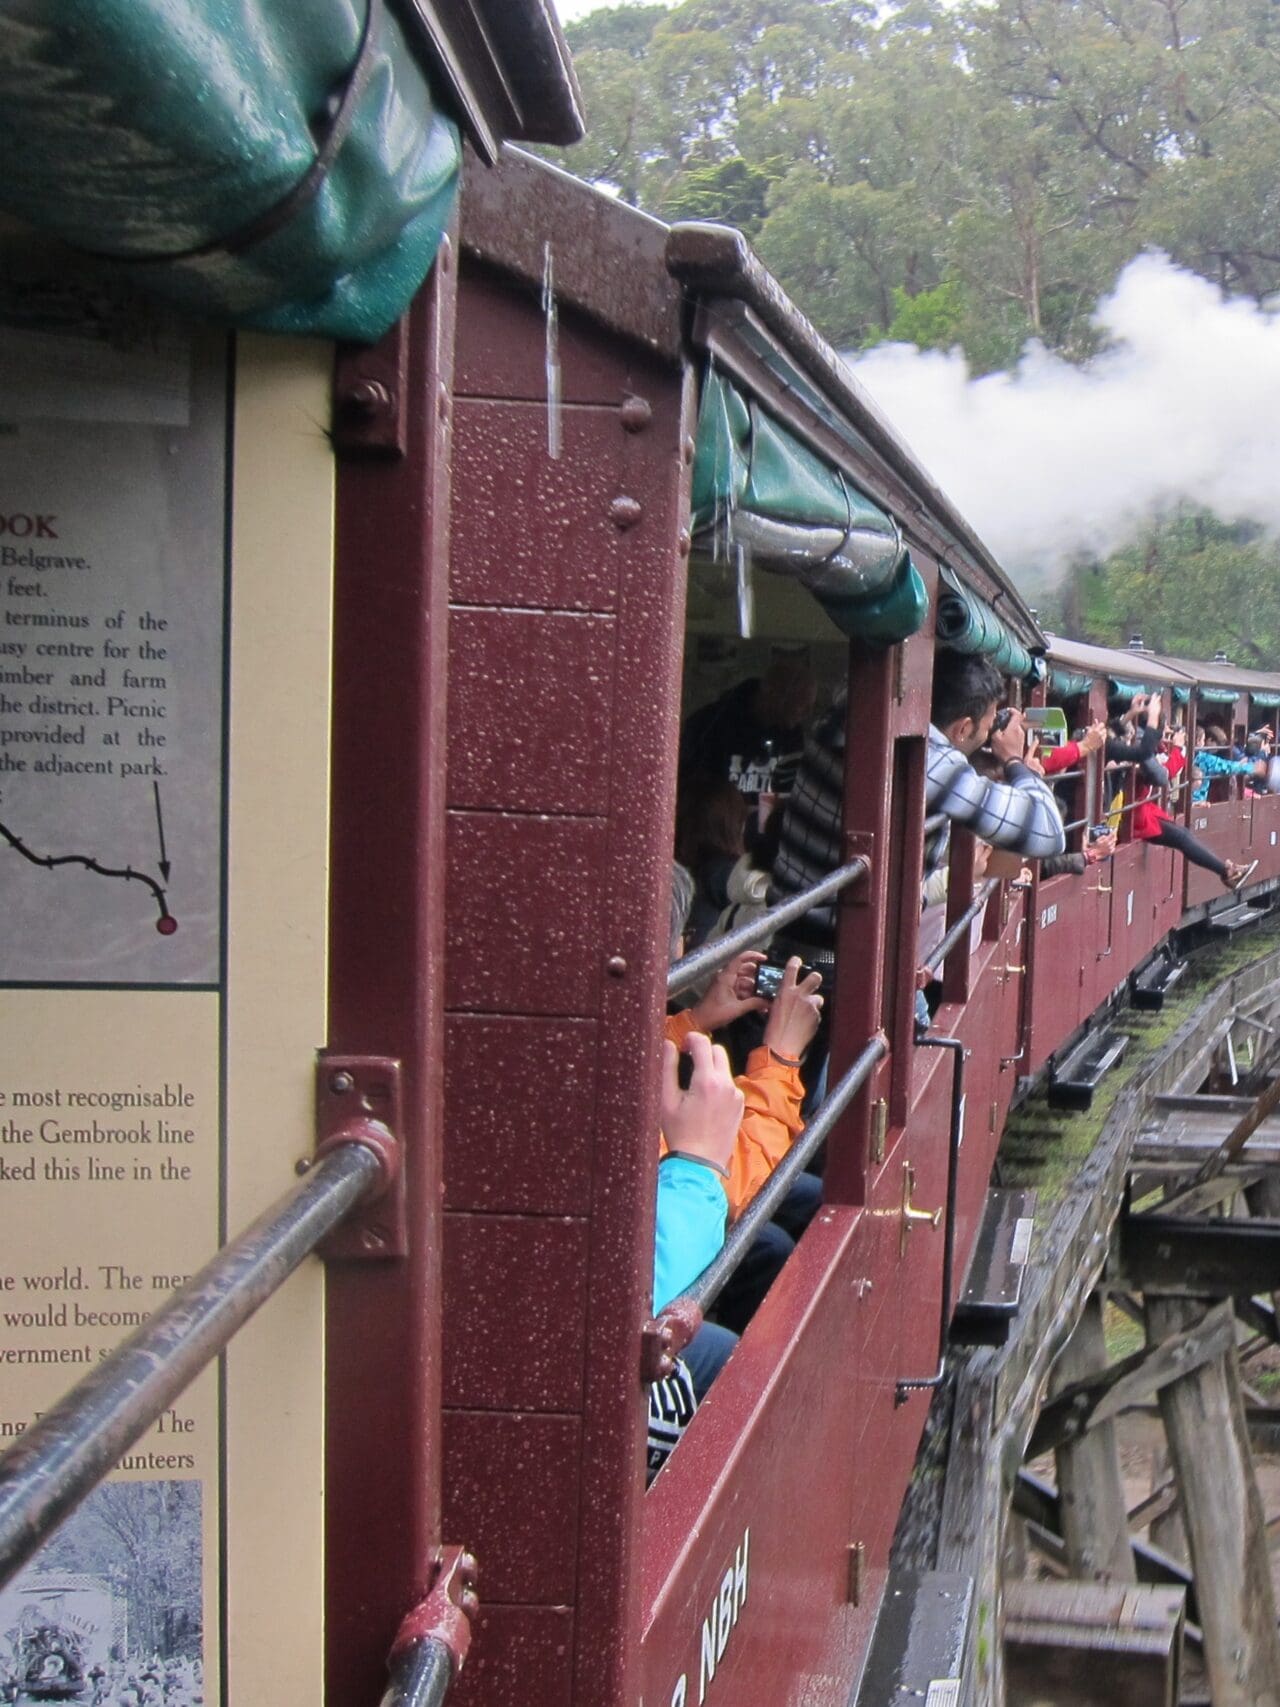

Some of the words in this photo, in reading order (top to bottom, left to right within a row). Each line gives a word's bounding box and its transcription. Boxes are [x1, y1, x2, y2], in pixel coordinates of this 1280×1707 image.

[1, 547, 91, 571] Belgrave.
[8, 577, 48, 598] feet.
[5, 608, 91, 629] terminus
[105, 612, 126, 629] of
[139, 613, 168, 632] the
[36, 642, 94, 658] centre
[103, 640, 130, 659] for
[139, 641, 167, 661] the
[70, 668, 106, 688] and
[122, 668, 167, 690] farm
[29, 695, 100, 716] district.
[107, 697, 167, 719] Picnic
[1, 724, 85, 746] provided
[103, 730, 120, 746] at
[138, 727, 167, 747] the
[34, 753, 113, 777] adjacent
[120, 756, 168, 779] park.
[12, 1089, 62, 1107] most
[67, 1084, 195, 1112] recognisable
[2, 1119, 34, 1144] the
[40, 1119, 152, 1145] Gembrook
[158, 1120, 195, 1144] line
[44, 1157, 81, 1181] this
[88, 1157, 126, 1181] line
[133, 1158, 152, 1181] in
[160, 1157, 192, 1181] the
[23, 1267, 90, 1291] world.
[99, 1266, 142, 1291] The
[4, 1303, 67, 1327] would
[115, 1452, 195, 1470] unteers
[698, 1526, 750, 1706] NBH
